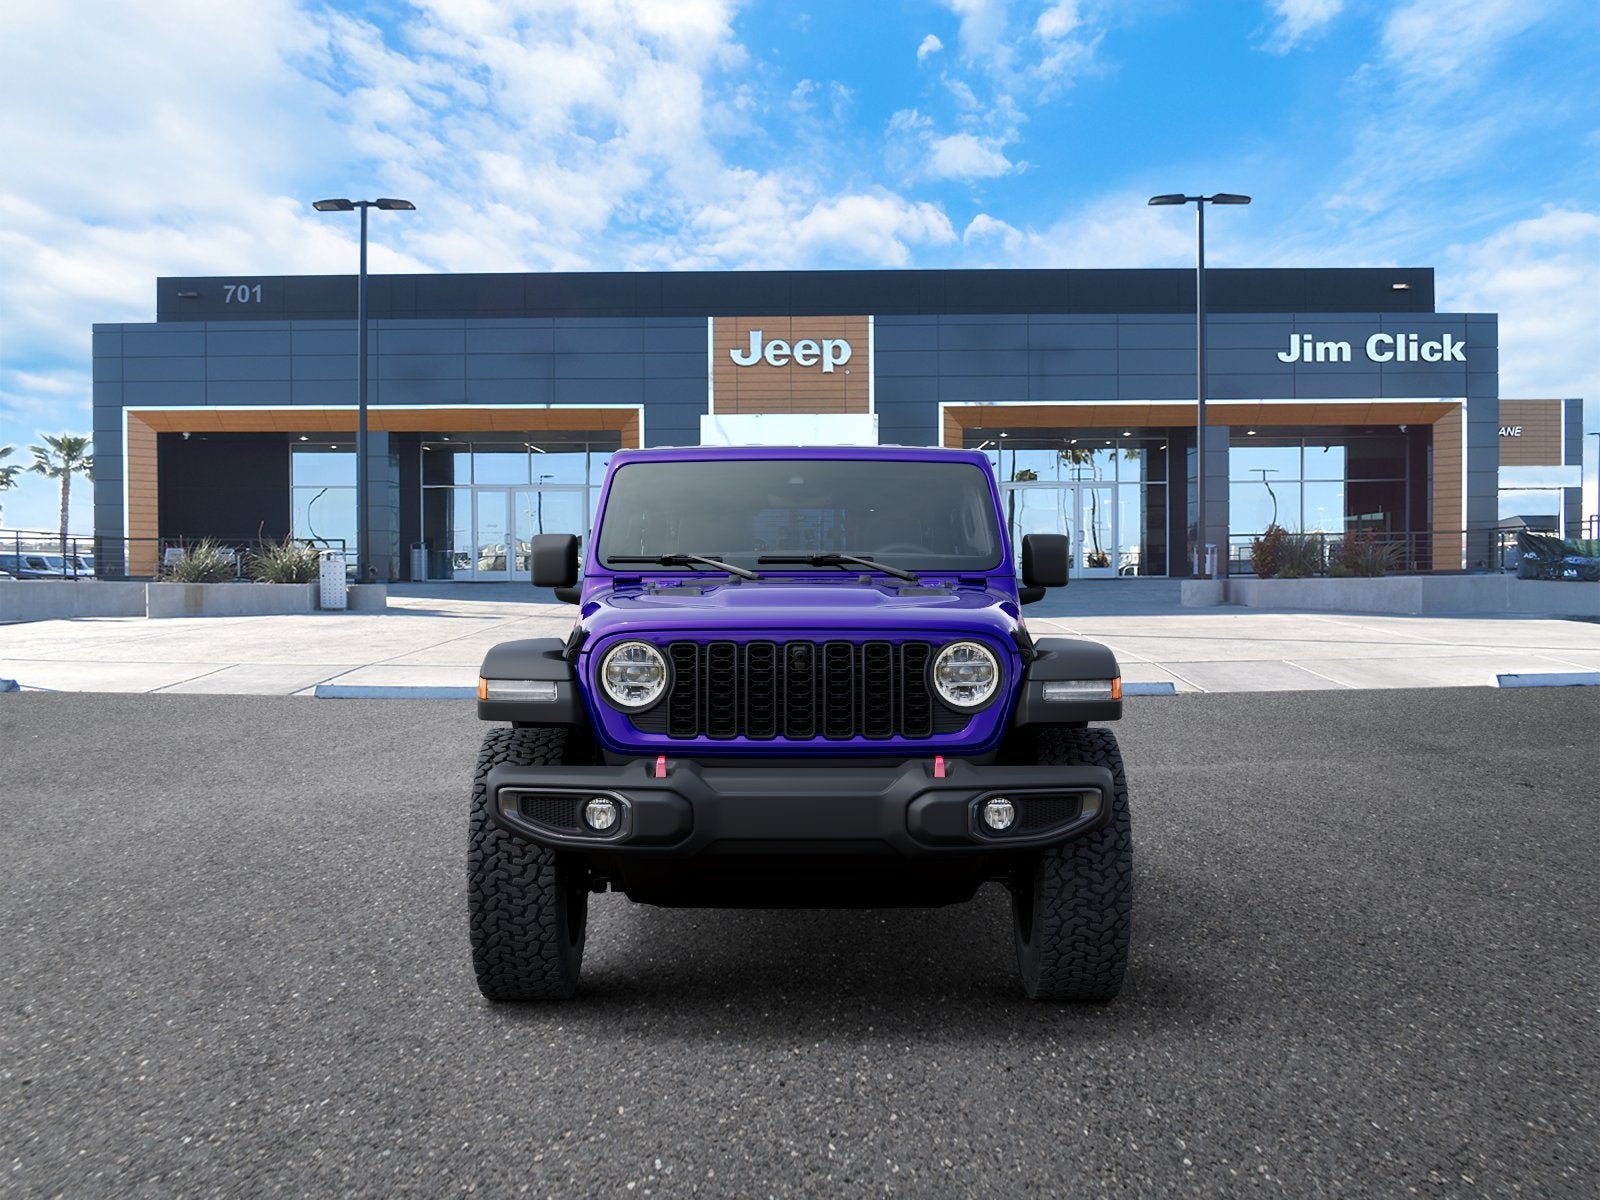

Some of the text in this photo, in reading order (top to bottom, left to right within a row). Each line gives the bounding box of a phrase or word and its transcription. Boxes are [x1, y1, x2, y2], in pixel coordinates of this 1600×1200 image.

[223, 284, 262, 303] 701
[729, 330, 852, 373] Jeep
[1277, 333, 1467, 363] Jim Click
